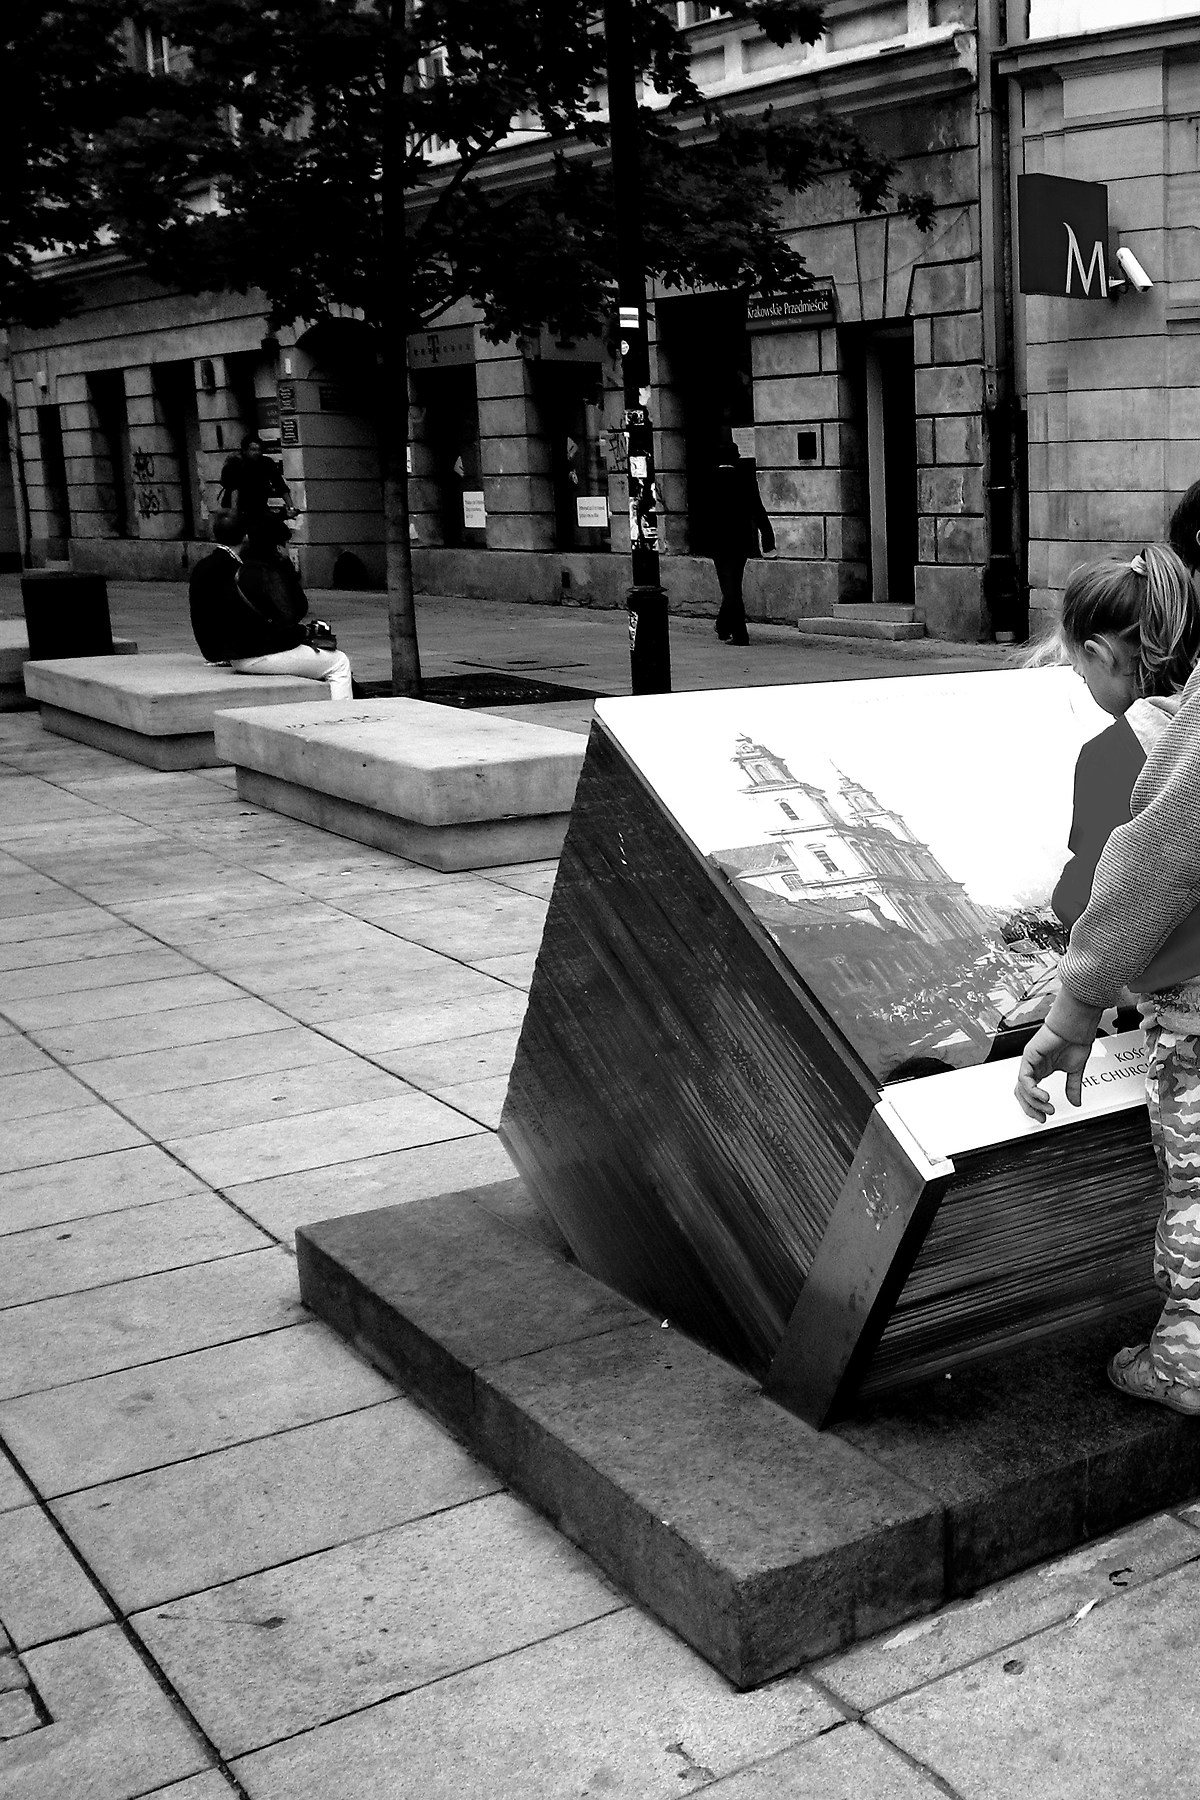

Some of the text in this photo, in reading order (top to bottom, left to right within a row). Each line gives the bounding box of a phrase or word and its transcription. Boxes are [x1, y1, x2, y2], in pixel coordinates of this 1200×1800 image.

[1063, 222, 1107, 298] M
[747, 298, 828, 319] Krakowskie Przedmieście
[1081, 1075, 1101, 1088] HE
